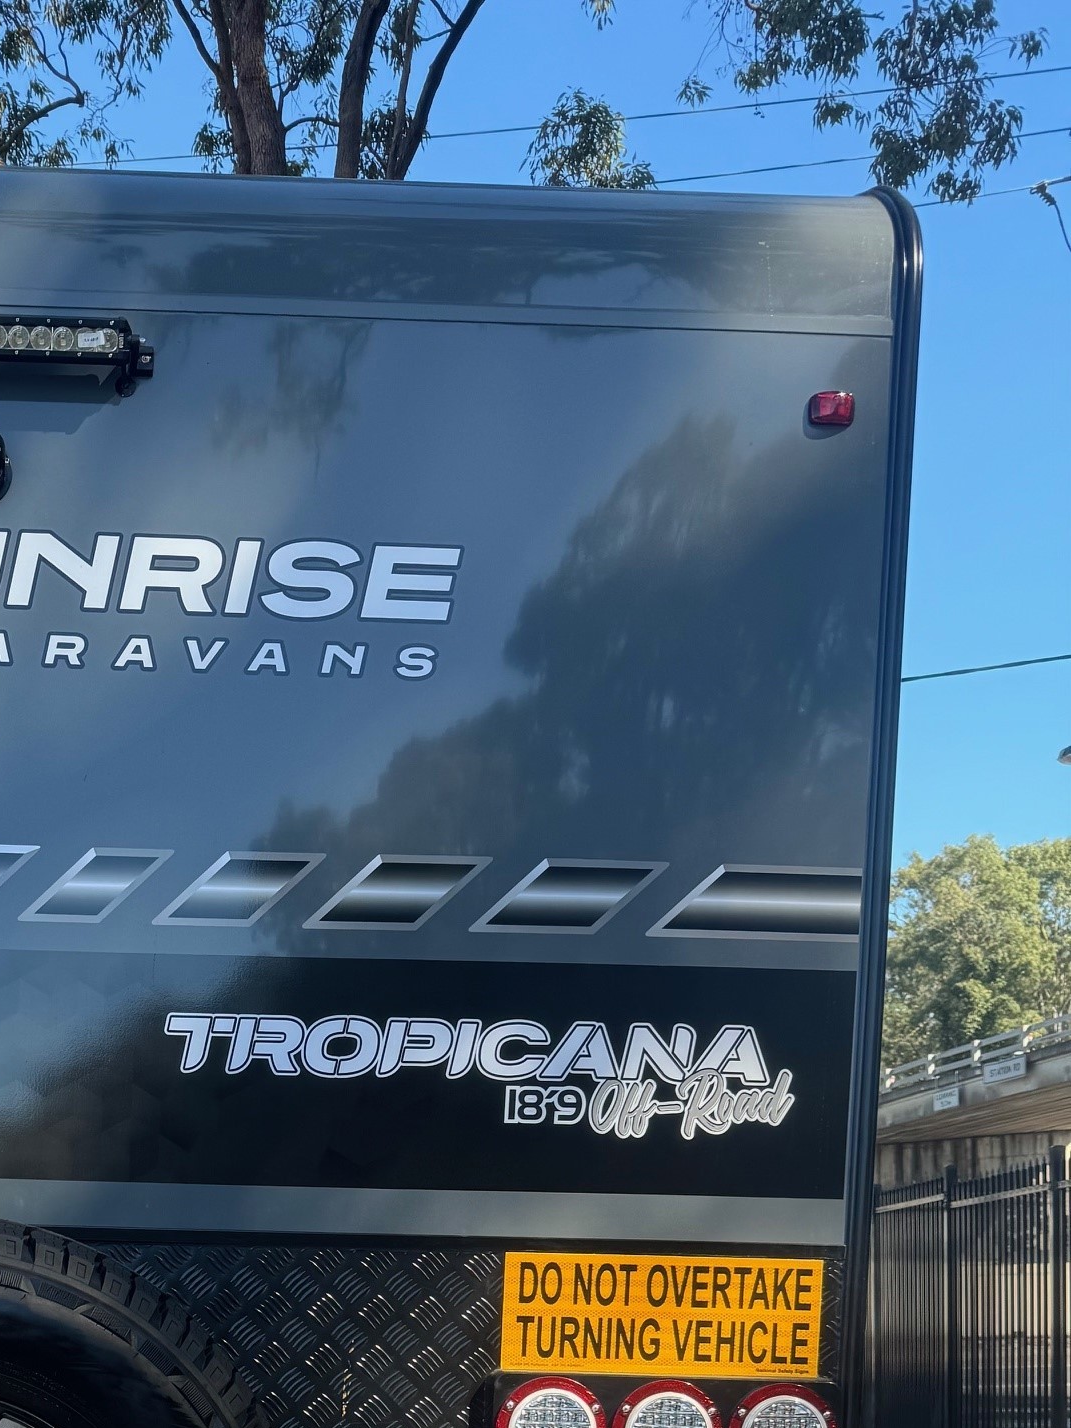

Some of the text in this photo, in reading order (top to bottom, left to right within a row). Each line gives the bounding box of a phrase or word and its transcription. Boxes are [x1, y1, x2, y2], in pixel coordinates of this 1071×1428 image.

[165, 1013, 771, 1086] TROPICANA
[589, 1069, 796, 1140] Off-Road
[518, 1262, 814, 1311] DO NOT OVERTAKE
[516, 1316, 810, 1365] TURNING VEHICLE
